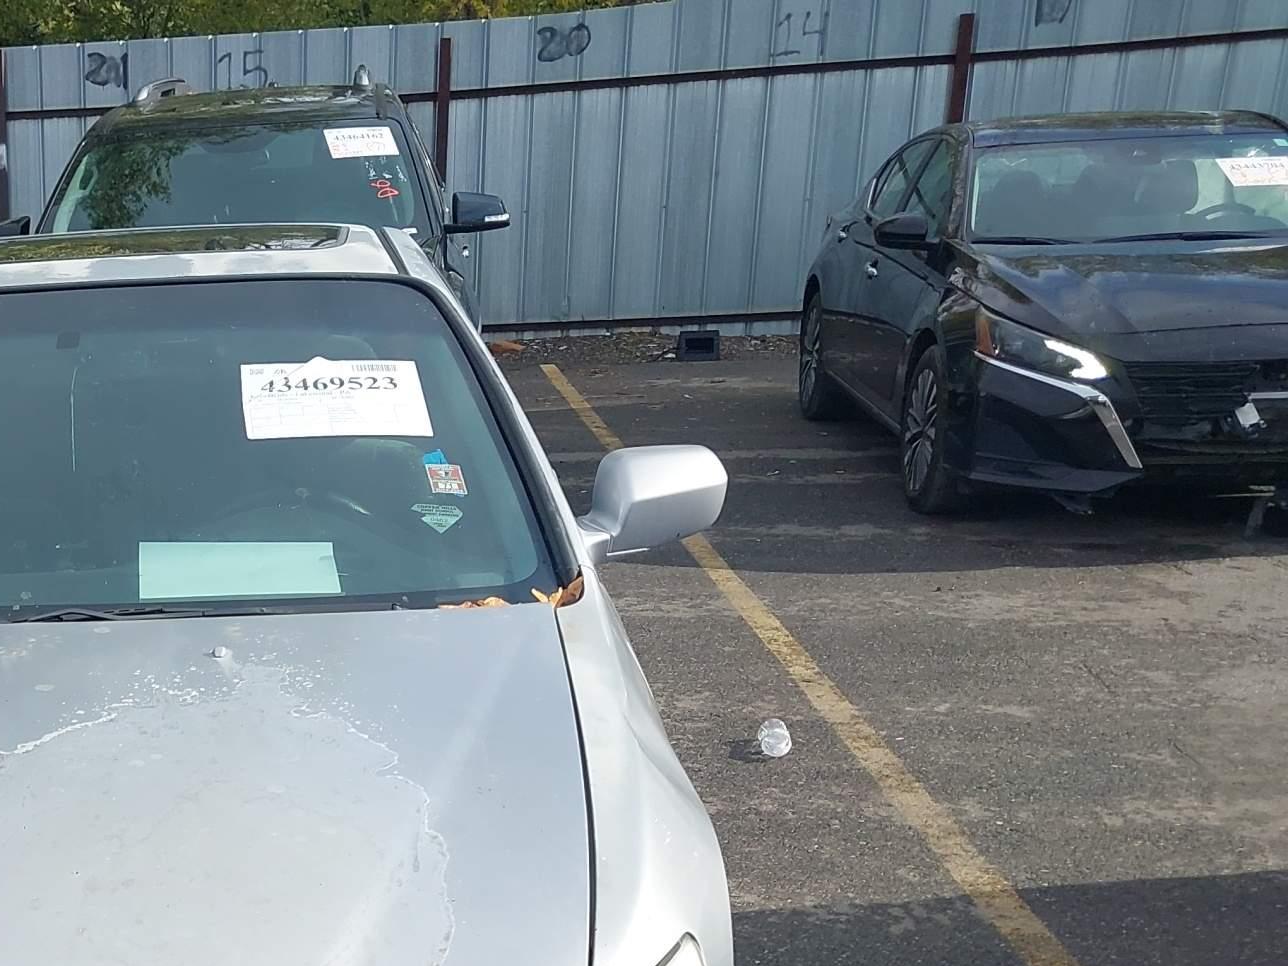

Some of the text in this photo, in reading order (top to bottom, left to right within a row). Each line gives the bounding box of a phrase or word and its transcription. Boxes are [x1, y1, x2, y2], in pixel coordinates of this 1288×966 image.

[536, 22, 592, 63] 20
[217, 50, 269, 90] 15
[260, 375, 399, 393] 43469523
